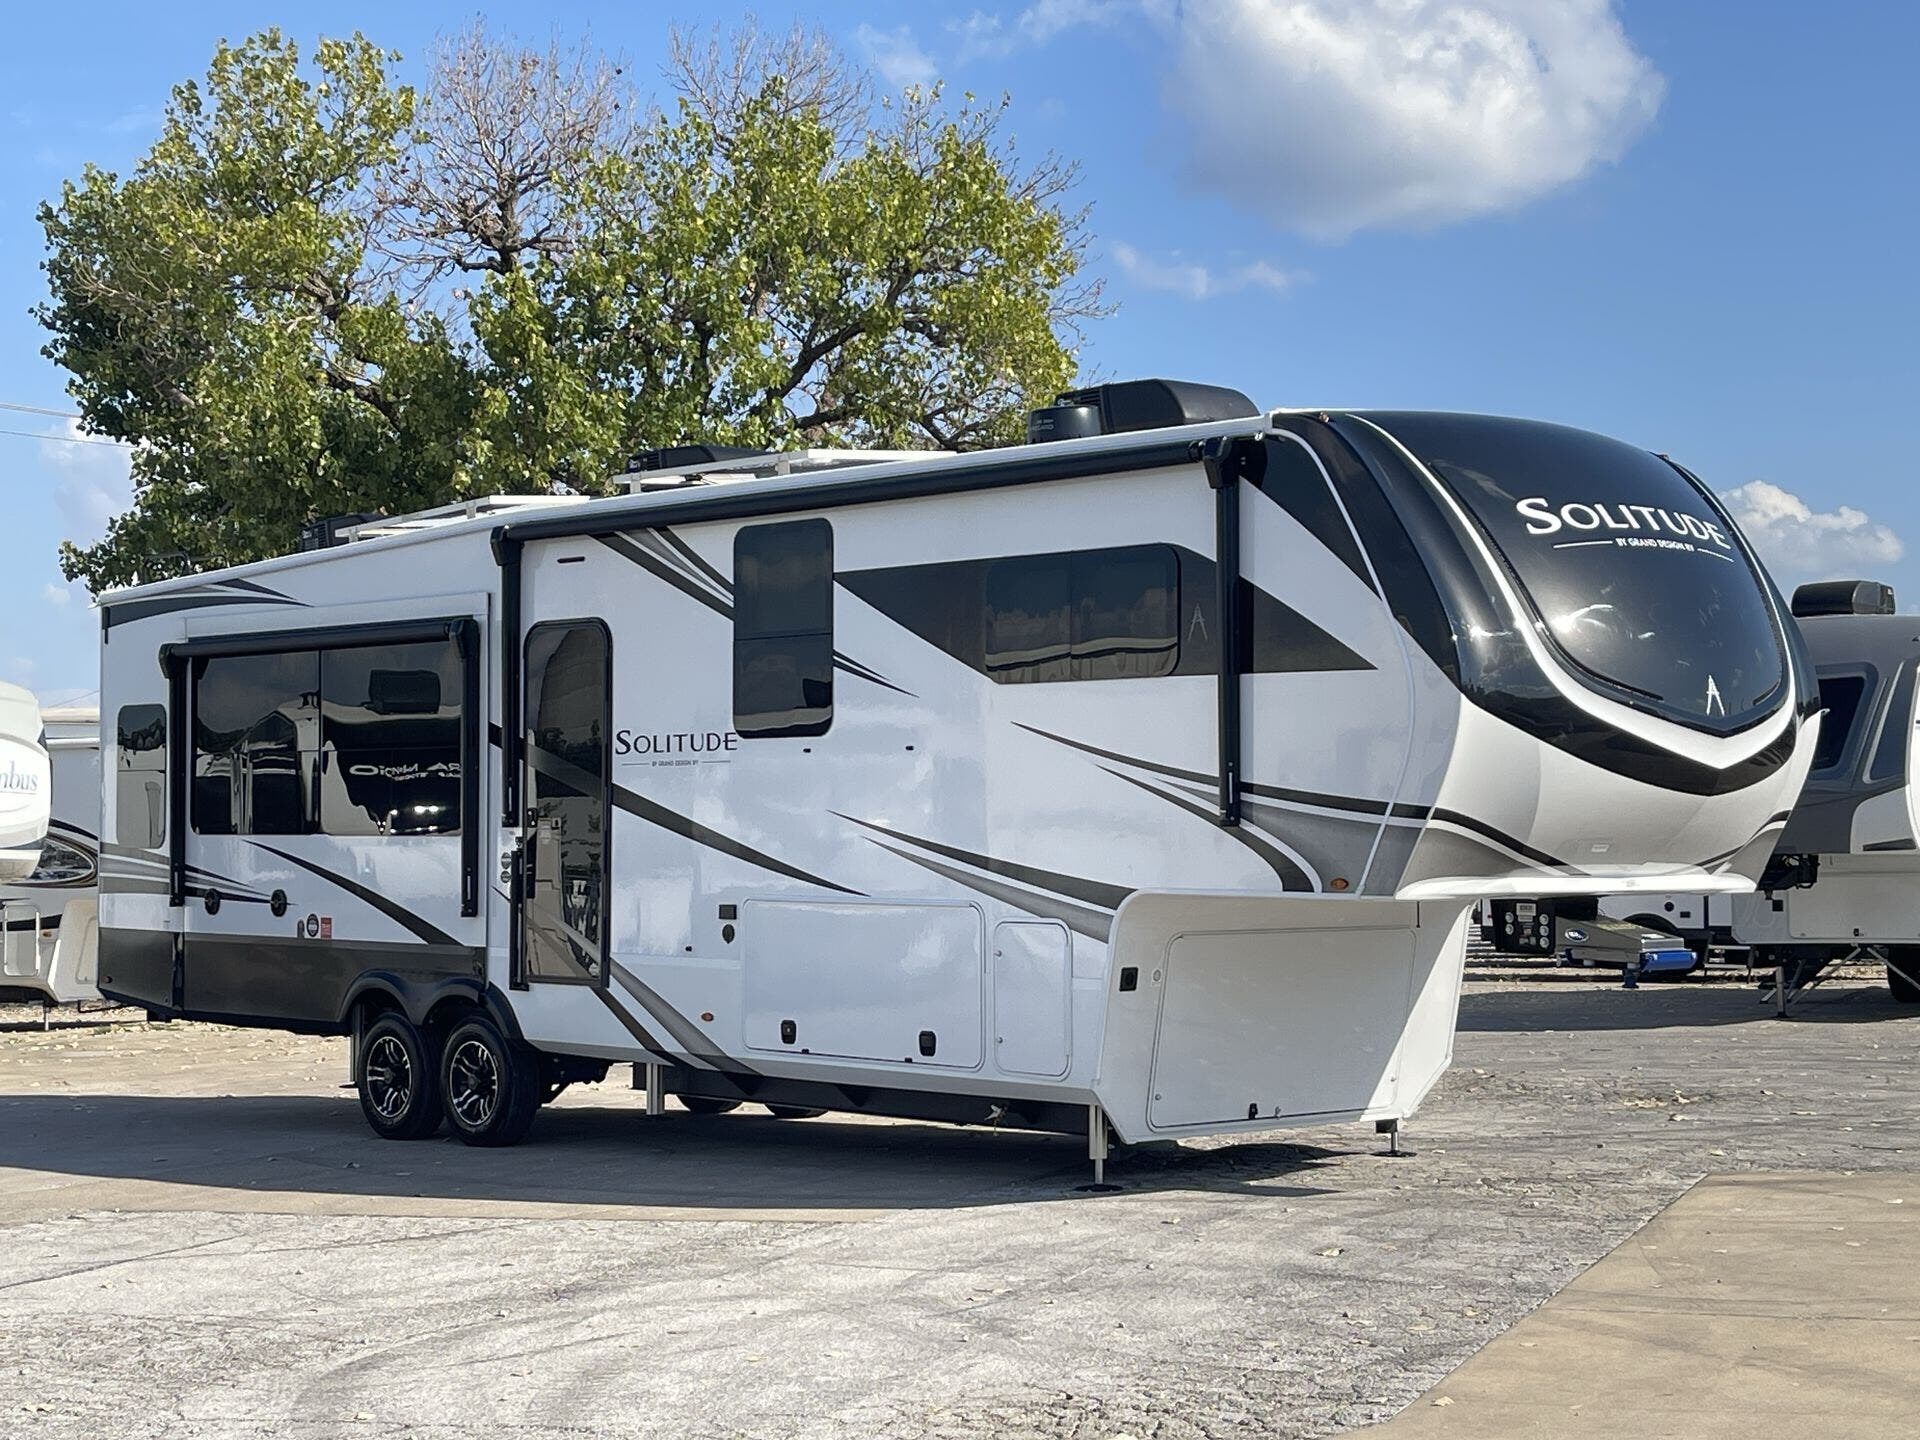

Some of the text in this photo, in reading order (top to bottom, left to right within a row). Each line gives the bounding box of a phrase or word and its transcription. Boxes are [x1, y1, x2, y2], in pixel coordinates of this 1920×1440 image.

[1515, 497, 1732, 550] SOLITUDE
[1627, 537, 1658, 548] GRAND
[1656, 539, 1686, 551] DESIGN
[615, 729, 738, 755] SOLITUDE
